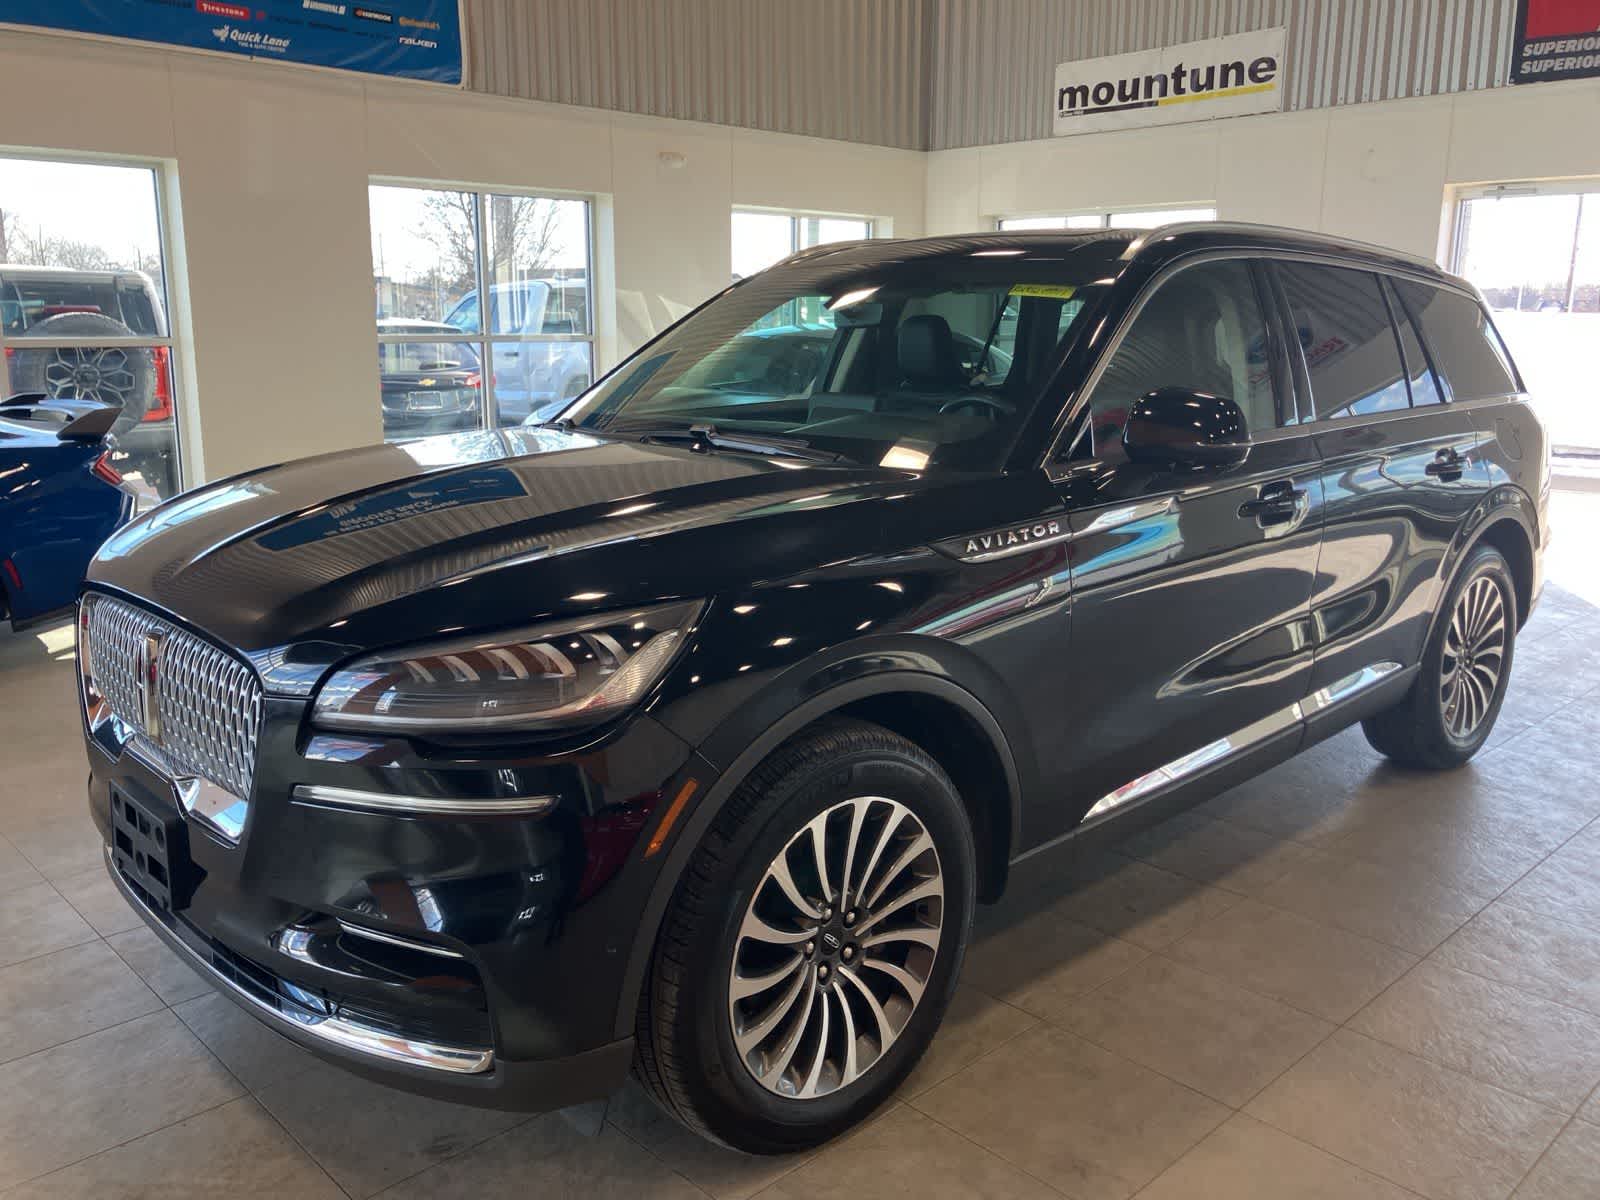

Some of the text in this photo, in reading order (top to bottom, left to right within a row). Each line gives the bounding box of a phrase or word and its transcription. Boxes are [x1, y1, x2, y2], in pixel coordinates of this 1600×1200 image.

[230, 29, 262, 43] Quick
[262, 34, 290, 47] Lane
[399, 36, 437, 48] FALKEN
[1058, 56, 1277, 110] mountune
[965, 521, 1060, 553] AVIATOR
